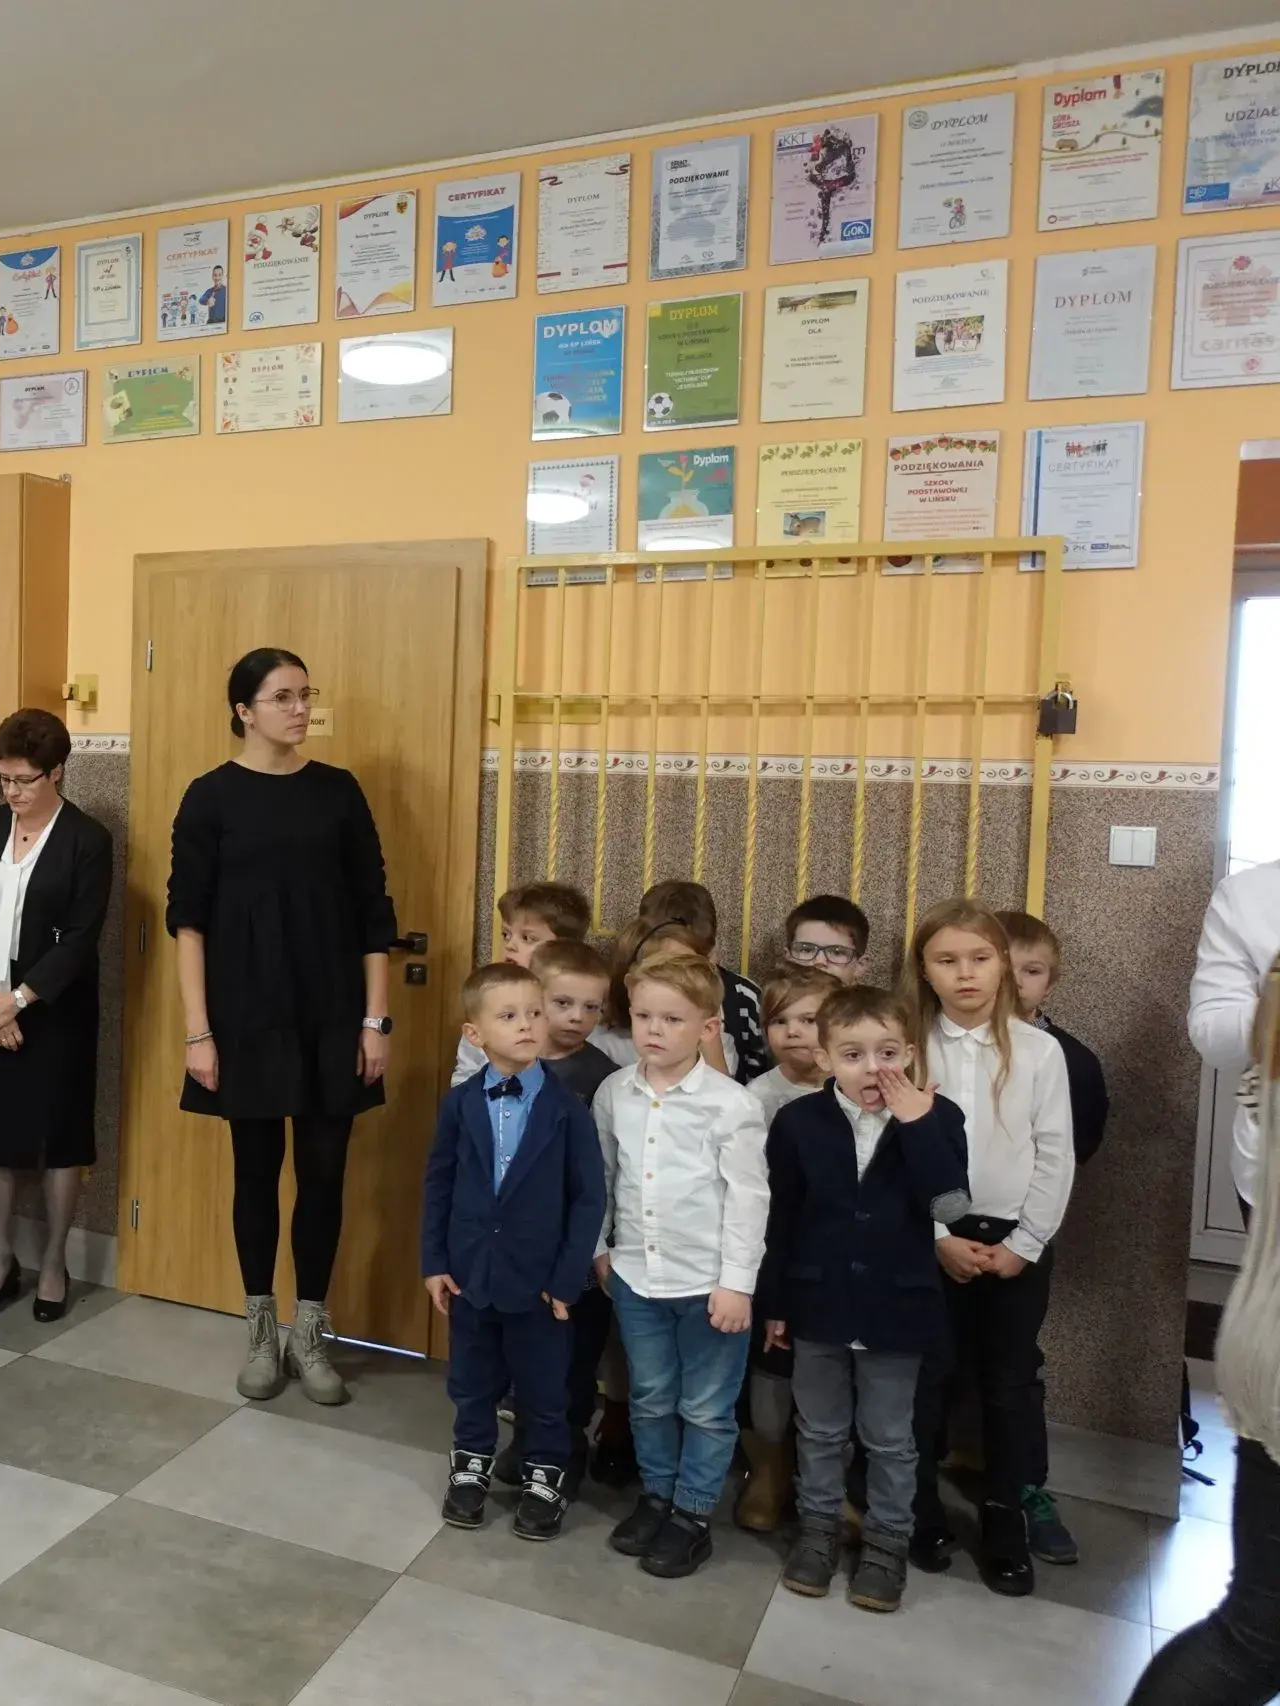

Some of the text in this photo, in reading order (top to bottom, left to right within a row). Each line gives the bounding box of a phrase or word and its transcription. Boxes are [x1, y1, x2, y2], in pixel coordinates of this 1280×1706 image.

[1054, 89, 1107, 108] Dyplom
[930, 113, 988, 131] DYPLOM
[669, 169, 730, 185] PODZIĘKOWANIE
[448, 187, 507, 203] CERTYFIKAT
[567, 193, 600, 205] DYPLOM
[363, 210, 389, 221] DYPLOM
[166, 247, 219, 262] CERTYFIKAT
[253, 256, 310, 269] PODZIĘKOWANIE
[1054, 290, 1132, 309] DYPLOM
[669, 305, 719, 321] DYPLOM
[543, 318, 618, 338] DYPLOM
[801, 317, 830, 327] DYPLOM
[808, 327, 823, 336] DLA
[1200, 334, 1276, 352] caritas
[693, 452, 730, 468] Dyplom
[894, 459, 986, 474] PODZIĘKOWANIA
[1048, 458, 1121, 474] CERTYFIKAT
[923, 479, 955, 487] SZKOŁY
[907, 487, 969, 496] PODSTAWOWEJ
[929, 494, 957, 503] LIŃSKU
